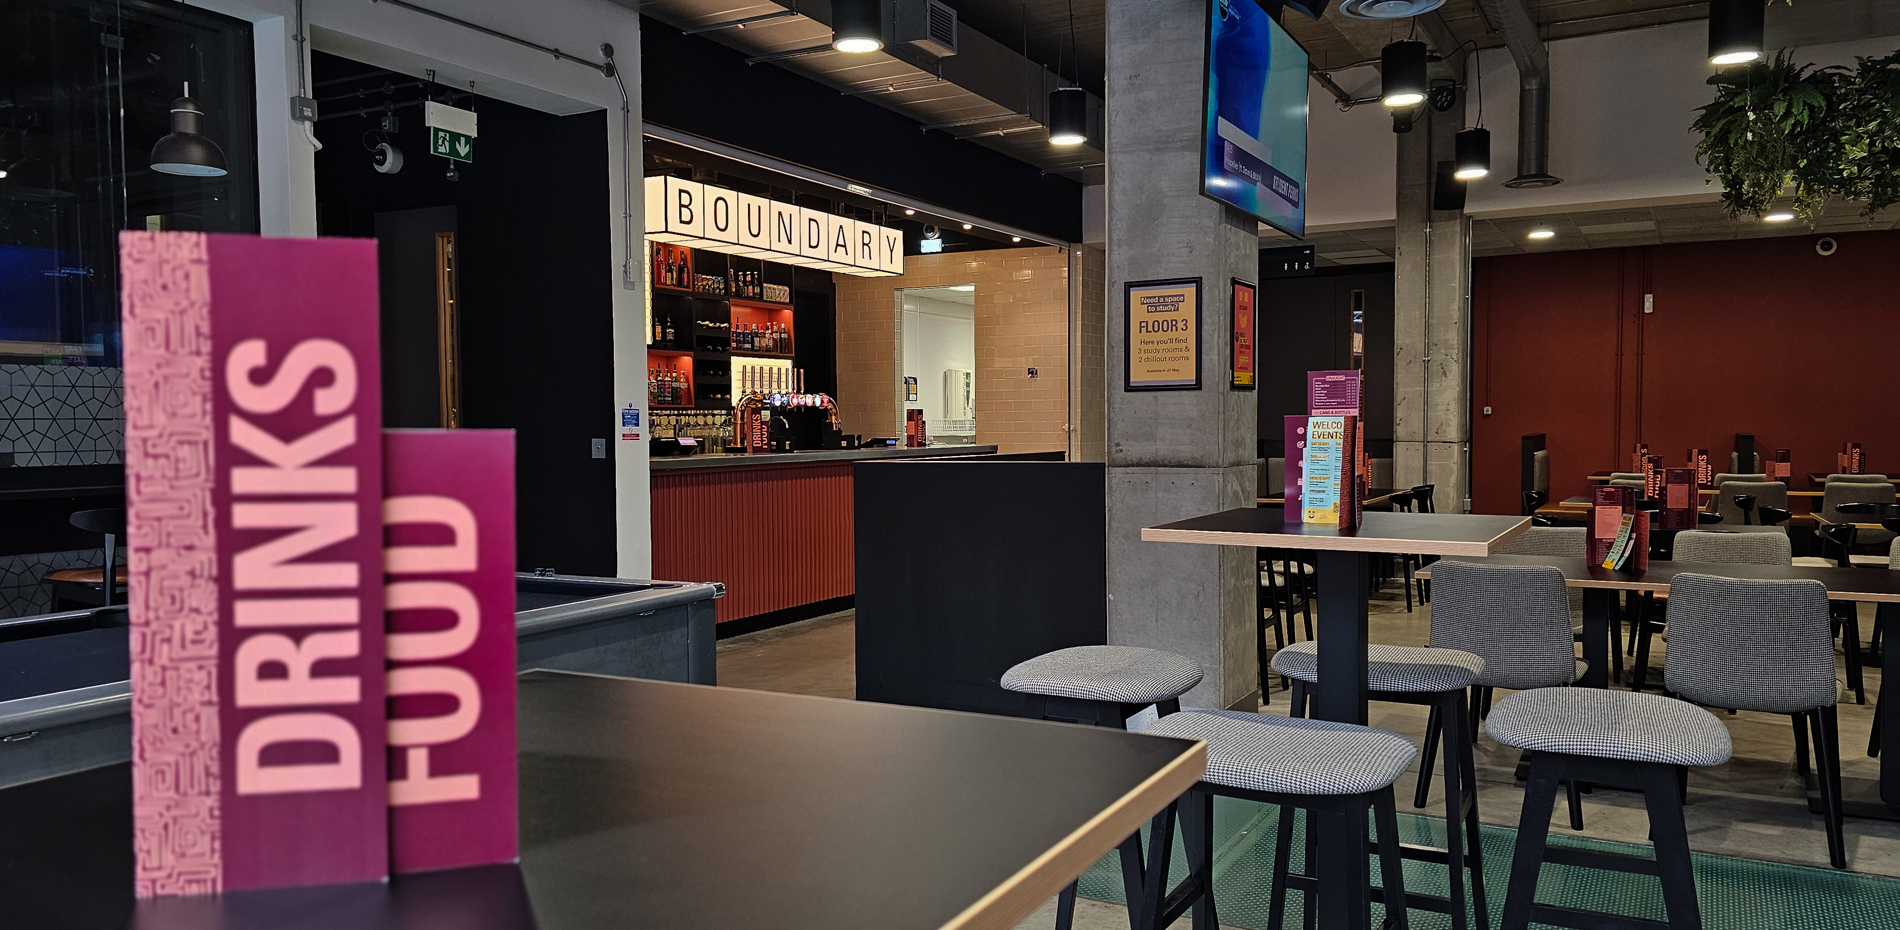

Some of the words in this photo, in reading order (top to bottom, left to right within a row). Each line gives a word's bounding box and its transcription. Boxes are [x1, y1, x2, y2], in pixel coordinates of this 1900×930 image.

[678, 188, 898, 265] BOUNDARY
[1139, 319, 1178, 333] FLOOR
[1181, 319, 1188, 331] 3
[752, 414, 761, 447] DRINKS
[1698, 454, 1707, 484] DRINKS
[1852, 448, 1860, 473] DRINKS
[225, 337, 362, 796] DRINKS
[383, 494, 482, 806] FOOD
